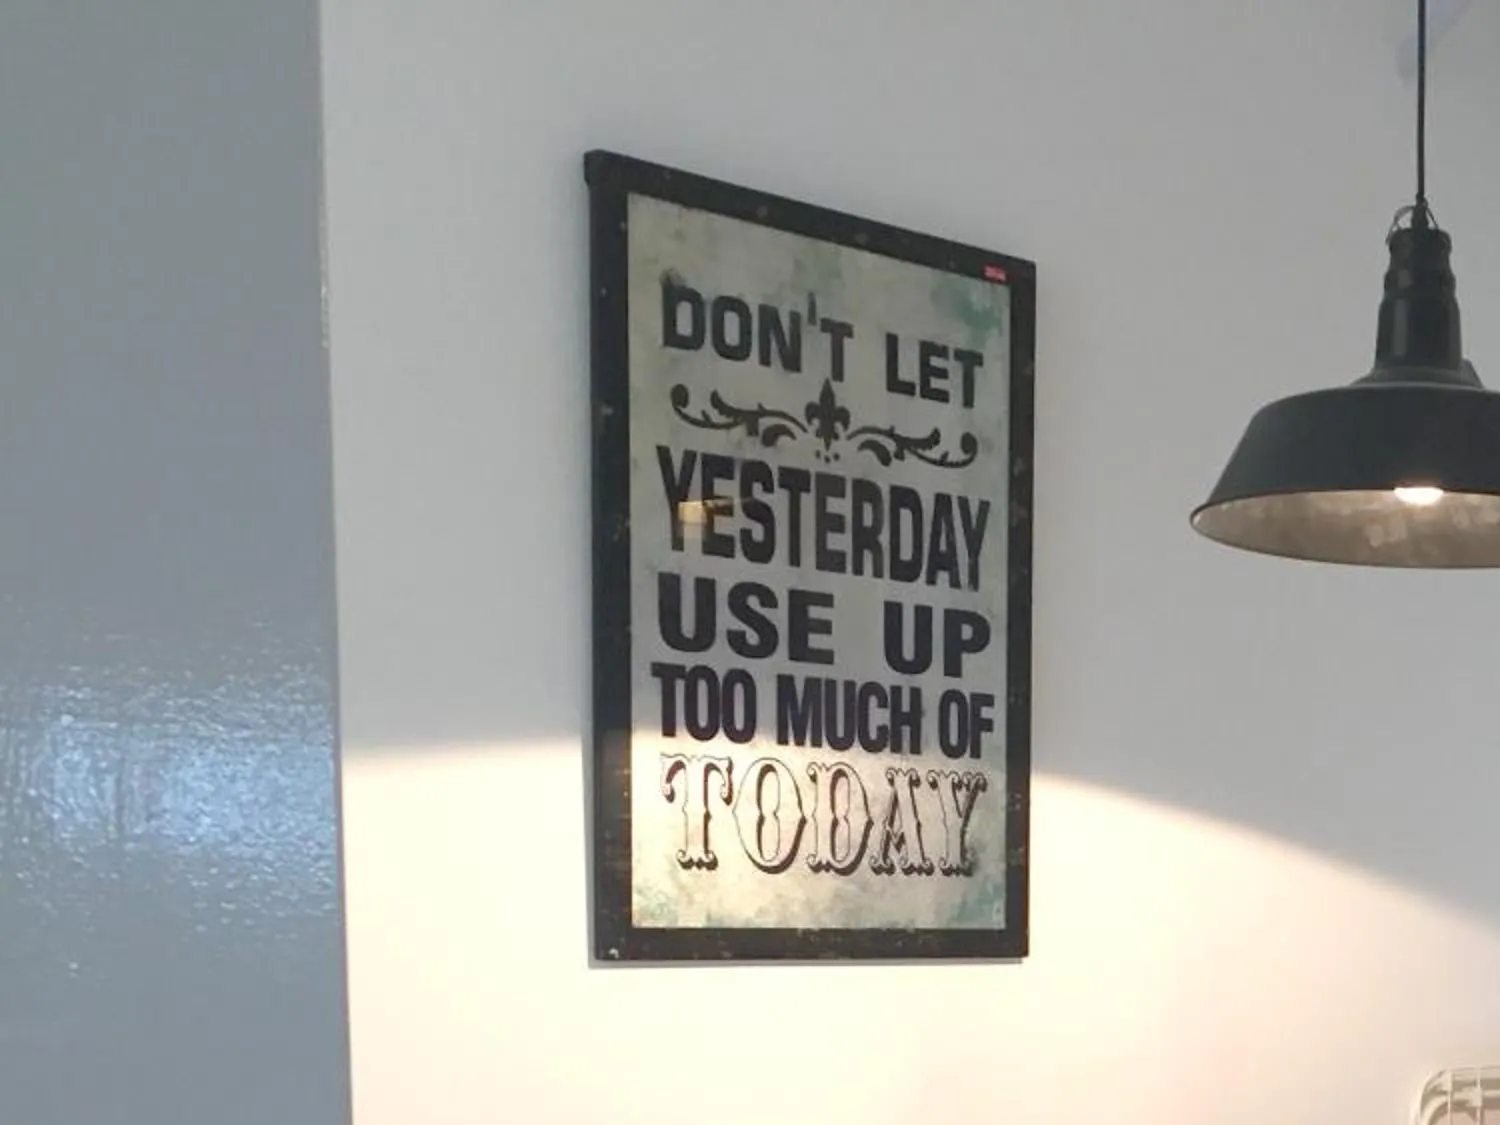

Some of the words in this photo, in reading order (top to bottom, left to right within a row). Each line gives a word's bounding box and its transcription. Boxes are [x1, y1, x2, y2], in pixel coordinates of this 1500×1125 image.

[661, 278, 854, 382] DON'T
[886, 332, 984, 409] LET
[656, 445, 991, 592] YESTERDAY
[657, 571, 835, 666] USE
[884, 600, 991, 678] UP
[651, 662, 757, 744] TOO
[776, 674, 922, 755] MUCH
[938, 689, 995, 759] OF
[660, 752, 988, 877] TODAY
